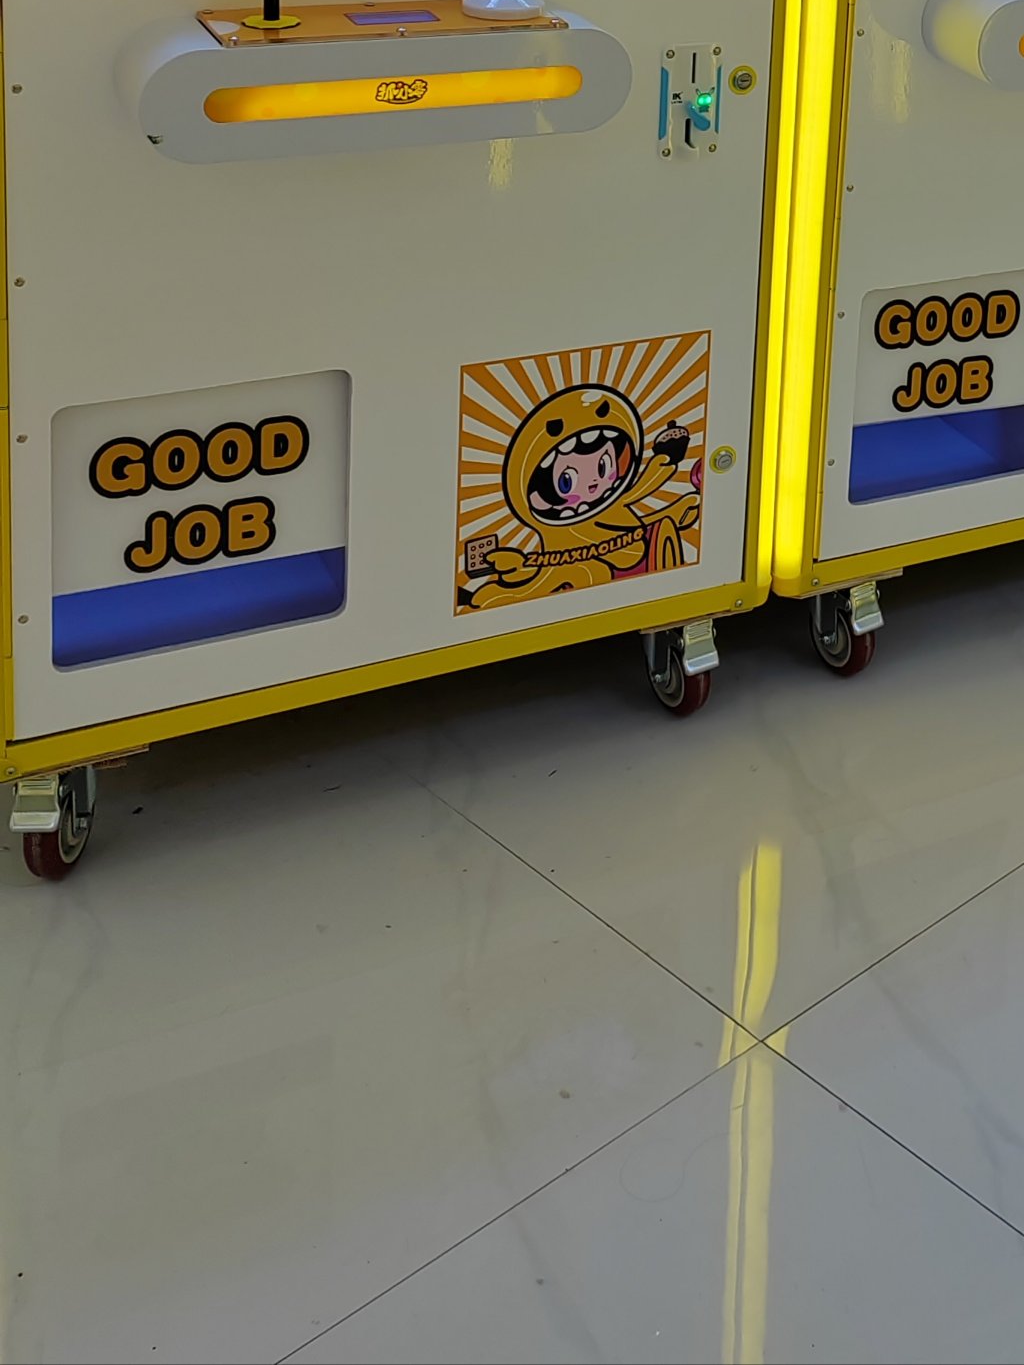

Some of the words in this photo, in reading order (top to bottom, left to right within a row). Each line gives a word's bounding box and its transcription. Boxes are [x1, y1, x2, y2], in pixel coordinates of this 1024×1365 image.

[875, 290, 1021, 350] GOOD
[892, 355, 994, 412] JOB
[90, 415, 309, 499] GOOD
[125, 495, 275, 573] JOB
[525, 529, 644, 567] ZHUAXIAOLING
